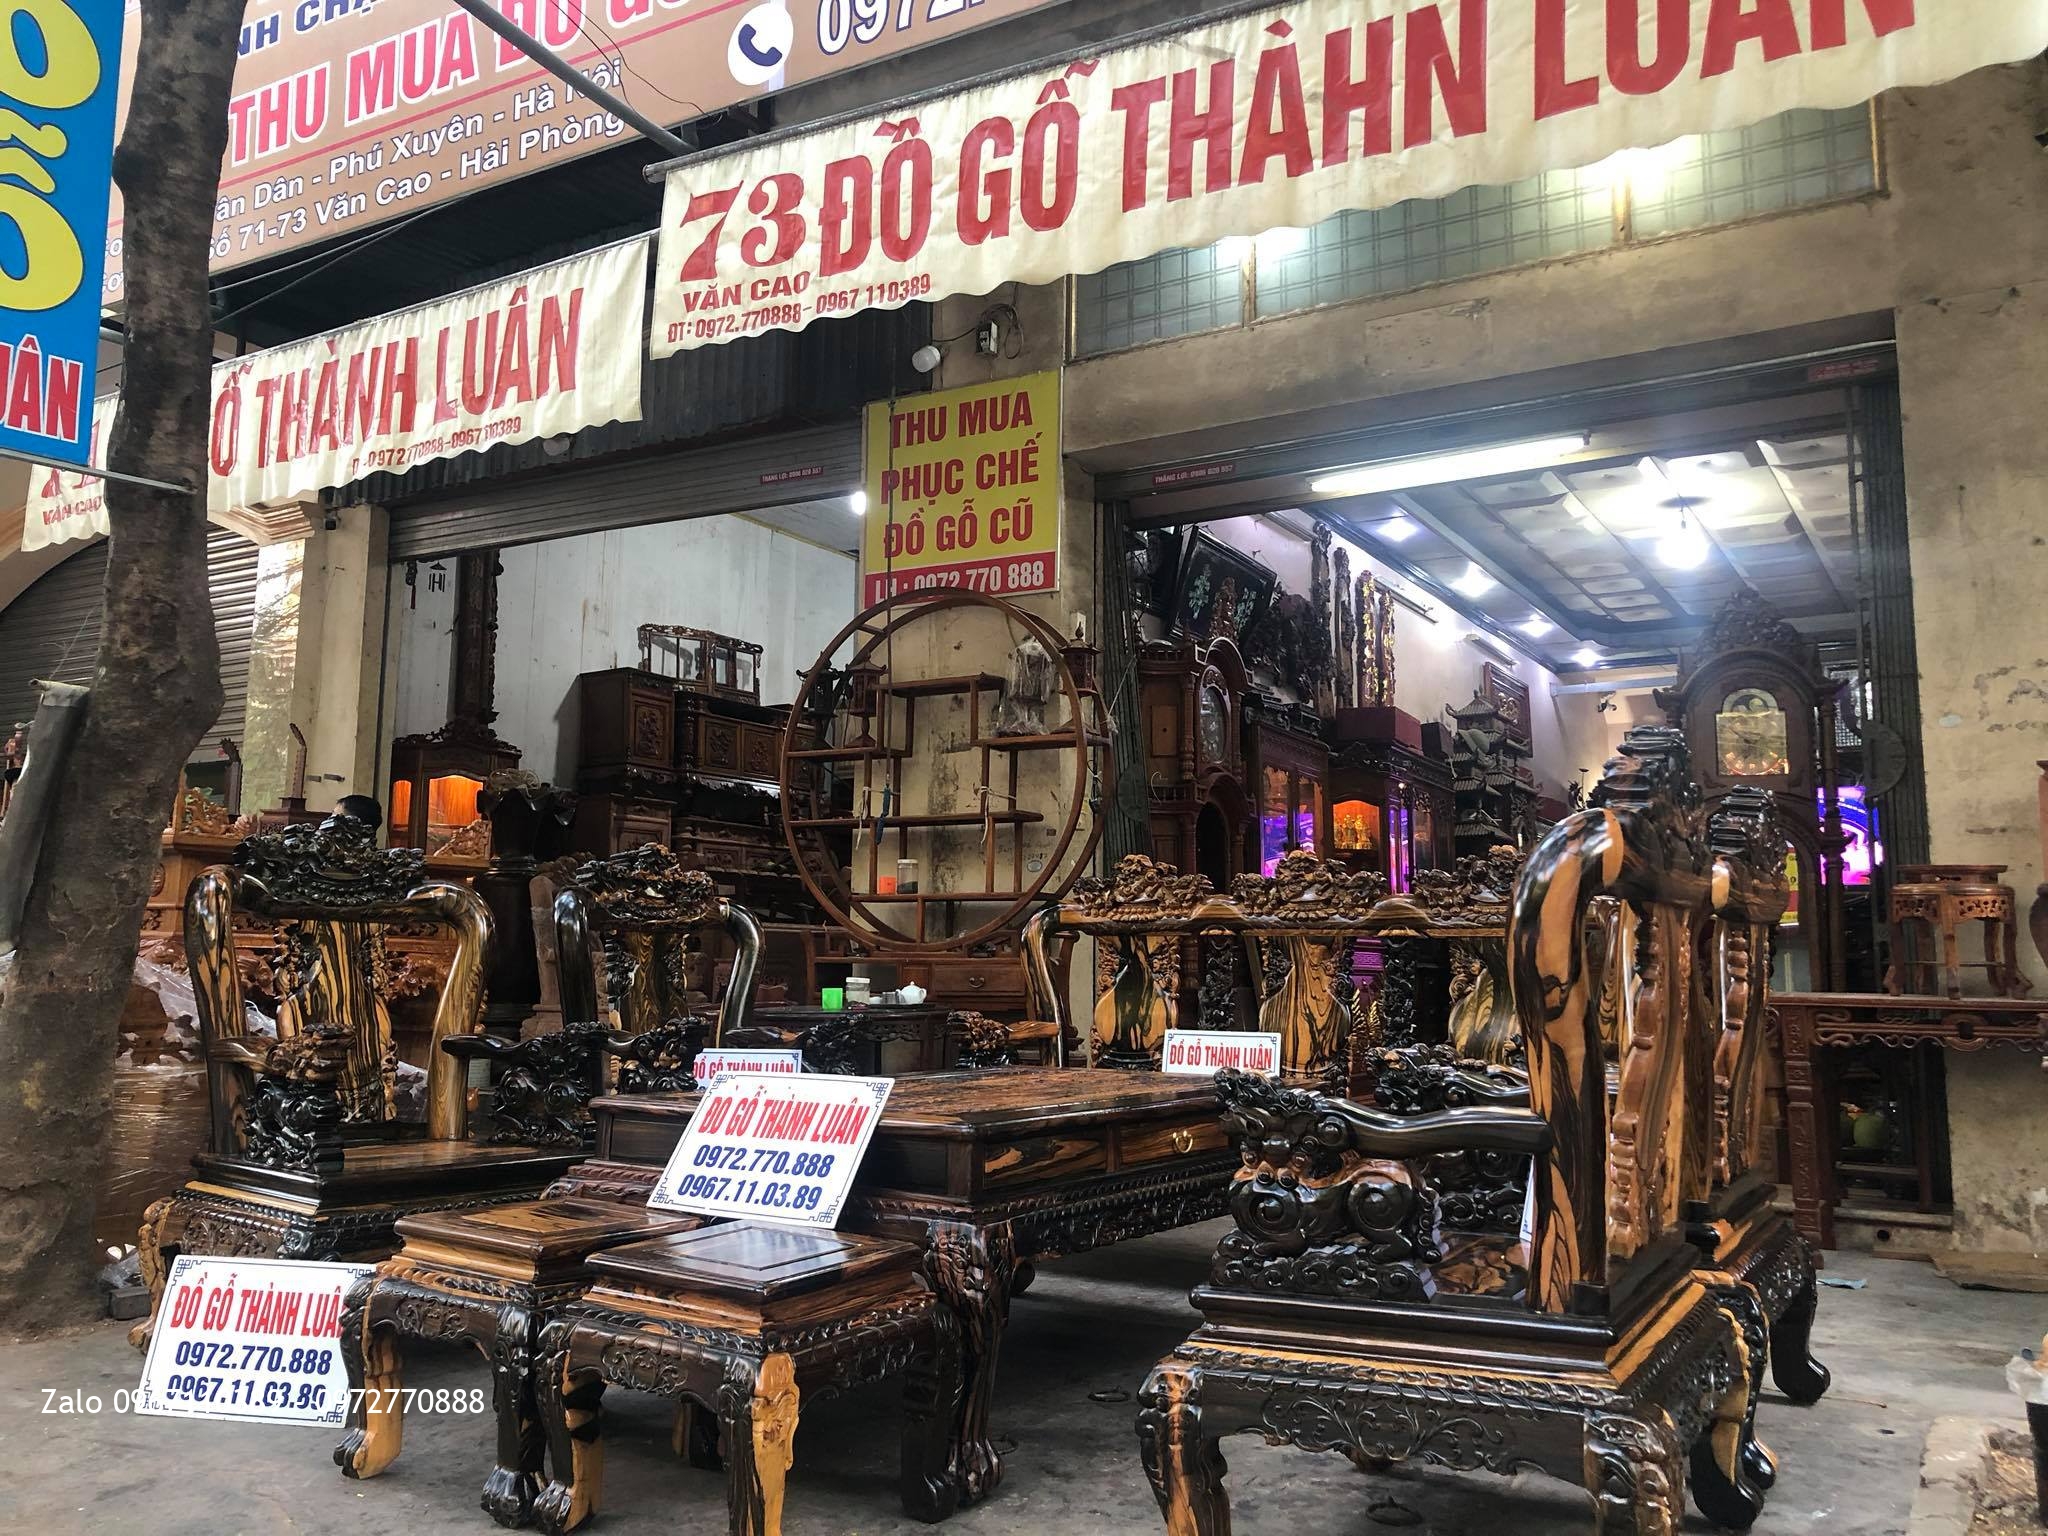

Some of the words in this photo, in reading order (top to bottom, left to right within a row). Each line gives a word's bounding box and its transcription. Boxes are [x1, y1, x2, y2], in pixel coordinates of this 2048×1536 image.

[230, 66, 327, 163] THU
[347, 12, 476, 122] MUA
[253, 176, 303, 209] Dân
[329, 141, 384, 184] Phú
[388, 113, 484, 165] Xuyên
[513, 84, 555, 121] Hà
[680, 173, 806, 282] 73
[818, 117, 932, 277] ĐỒ
[956, 59, 1100, 246] GỖ
[239, 207, 307, 250] 71-73
[314, 191, 366, 226] Văn
[375, 171, 432, 206] Cao
[459, 138, 510, 180] Hải
[519, 111, 625, 160] Phòng
[683, 284, 742, 312] VĂN
[750, 271, 811, 301] CAO
[865, 273, 931, 306] 110389
[256, 339, 420, 468] THÀNH
[433, 285, 584, 425] LUÂN
[892, 406, 947, 448] THU
[958, 391, 1033, 437] MUA
[881, 458, 964, 505] PHỤC
[975, 431, 1043, 490] CHẾ
[883, 507, 925, 558] ĐỒ
[935, 498, 978, 552] GỖ
[989, 497, 1033, 545] CŨ
[966, 566, 1001, 592] 770
[1007, 560, 1044, 589] 888
[1187, 1038, 1201, 1066] GỖ
[1205, 1043, 1240, 1067] THÀNH
[1243, 1044, 1272, 1069] LUÂN
[810, 1097, 870, 1145] LUÂN
[693, 1144, 835, 1178] 0972.770.888
[677, 1173, 823, 1211] 0967.11.03.89
[202, 1273, 238, 1331] GỖ
[175, 1340, 333, 1375] 0972.770.888
